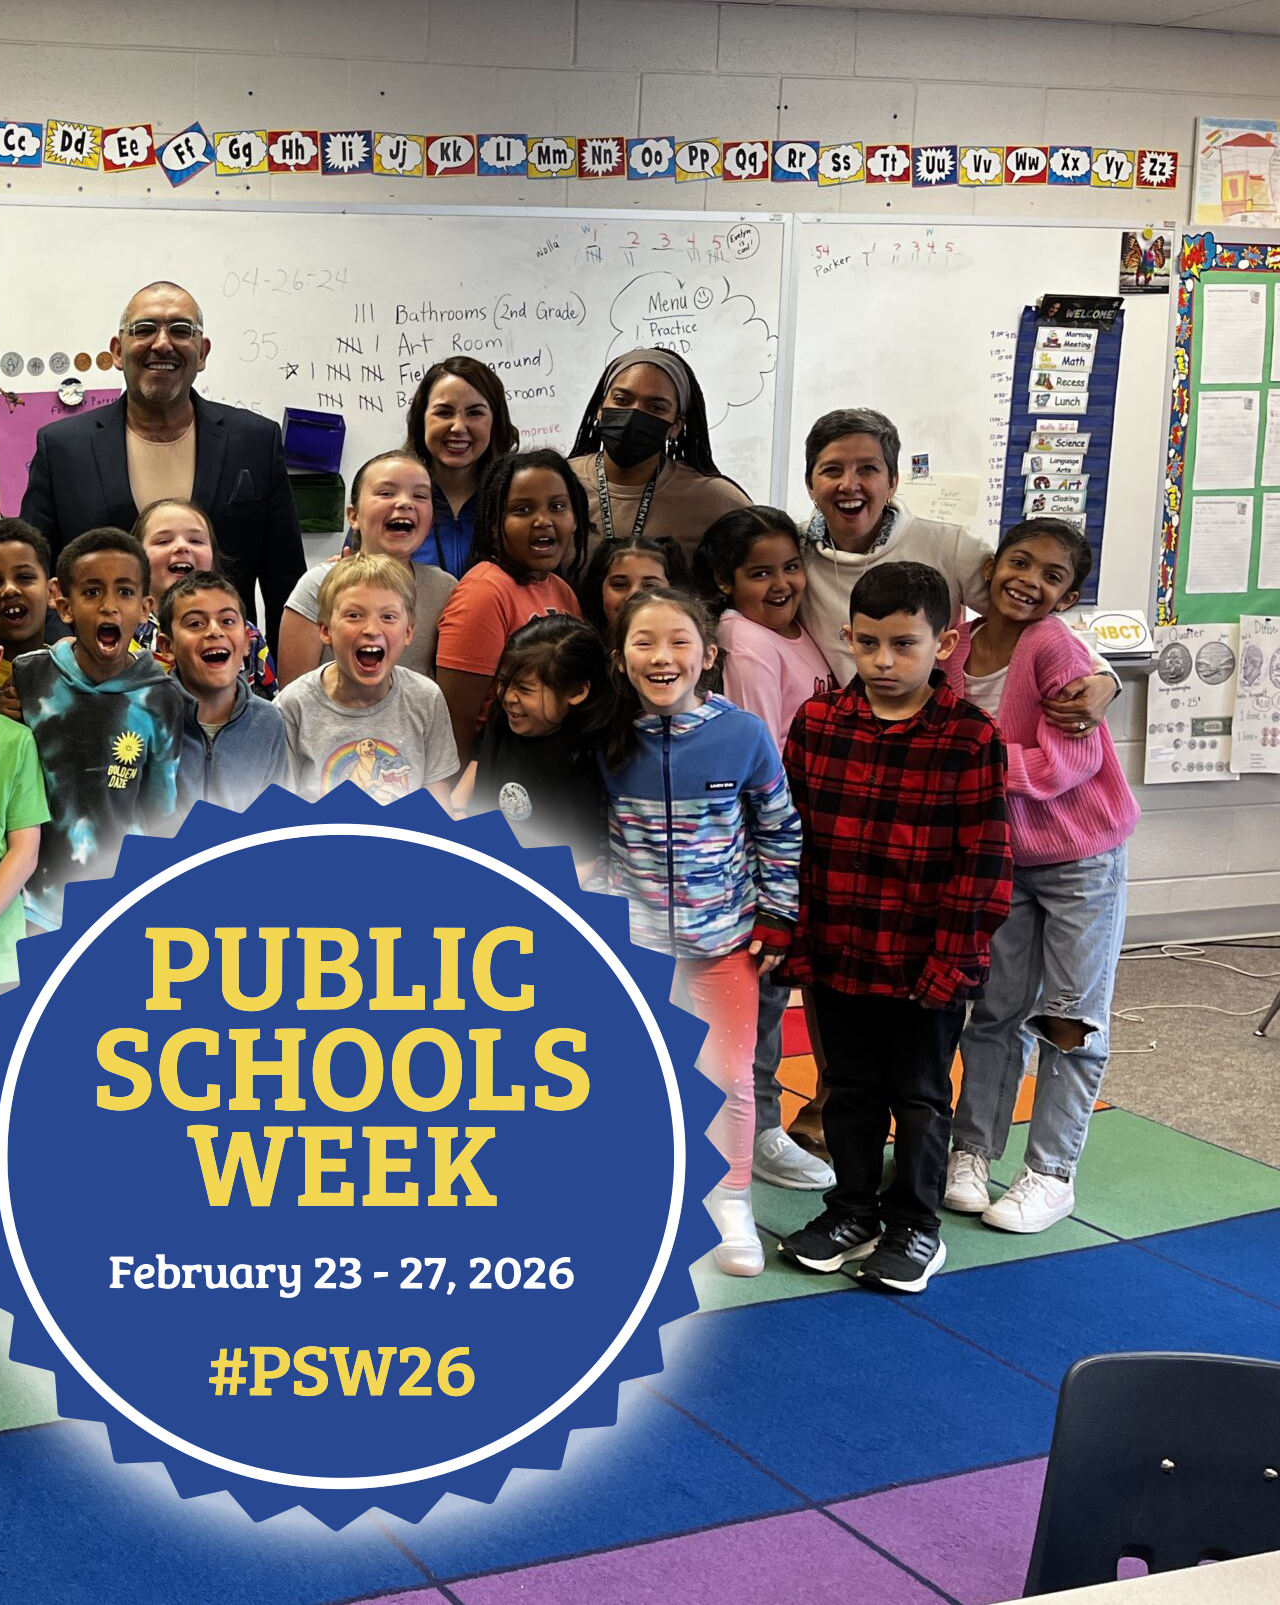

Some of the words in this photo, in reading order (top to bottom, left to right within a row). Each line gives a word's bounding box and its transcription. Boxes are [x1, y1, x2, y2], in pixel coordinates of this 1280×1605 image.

[4, 129, 26, 150] Cc
[60, 130, 85, 155] Dd
[117, 136, 139, 158] Ee
[282, 138, 304, 160] Hh
[173, 137, 196, 164] Ff
[228, 138, 252, 166] Gg
[342, 142, 353, 162] Ii
[390, 140, 406, 168] Jj
[440, 140, 462, 162] Kk
[496, 141, 511, 161] Ll
[538, 146, 568, 166] Mm
[592, 145, 612, 165] Nn
[642, 146, 662, 167] Oo
[688, 146, 709, 170] Pp
[788, 148, 806, 168] Rr
[735, 149, 758, 173] Qq
[831, 153, 851, 172] Ss
[880, 153, 897, 172] Tt
[926, 155, 946, 174] Uu
[973, 155, 992, 174] Vv
[1015, 152, 1040, 171] Ww
[1060, 152, 1080, 171] Xx
[1106, 156, 1124, 180] Yy
[1150, 158, 1166, 176] Zz
[730, 229, 751, 243] Evelyn
[813, 256, 852, 277] Parker
[396, 302, 487, 325] Bathrooms
[493, 294, 526, 330] (2nd
[536, 291, 586, 326] Grade)
[648, 291, 688, 313] Menu
[1066, 308, 1116, 320] WELCOME!
[650, 320, 698, 338] Practice
[1065, 331, 1092, 340] Morning
[398, 332, 434, 357] Art
[452, 333, 502, 352] Room
[1064, 342, 1090, 350] Meeting
[1062, 356, 1085, 366] Math
[1056, 377, 1085, 387] Recess
[1054, 396, 1080, 406] Lunch
[1055, 438, 1086, 448] Science
[1050, 457, 1080, 466] Language
[1058, 479, 1082, 490] Art
[1051, 504, 1074, 512] Circle
[1052, 496, 1080, 504] Closing
[1094, 624, 1142, 640] NBCT
[1170, 628, 1205, 642] Quarter
[108, 765, 138, 779] GOLDEN
[108, 776, 128, 788] DAZE
